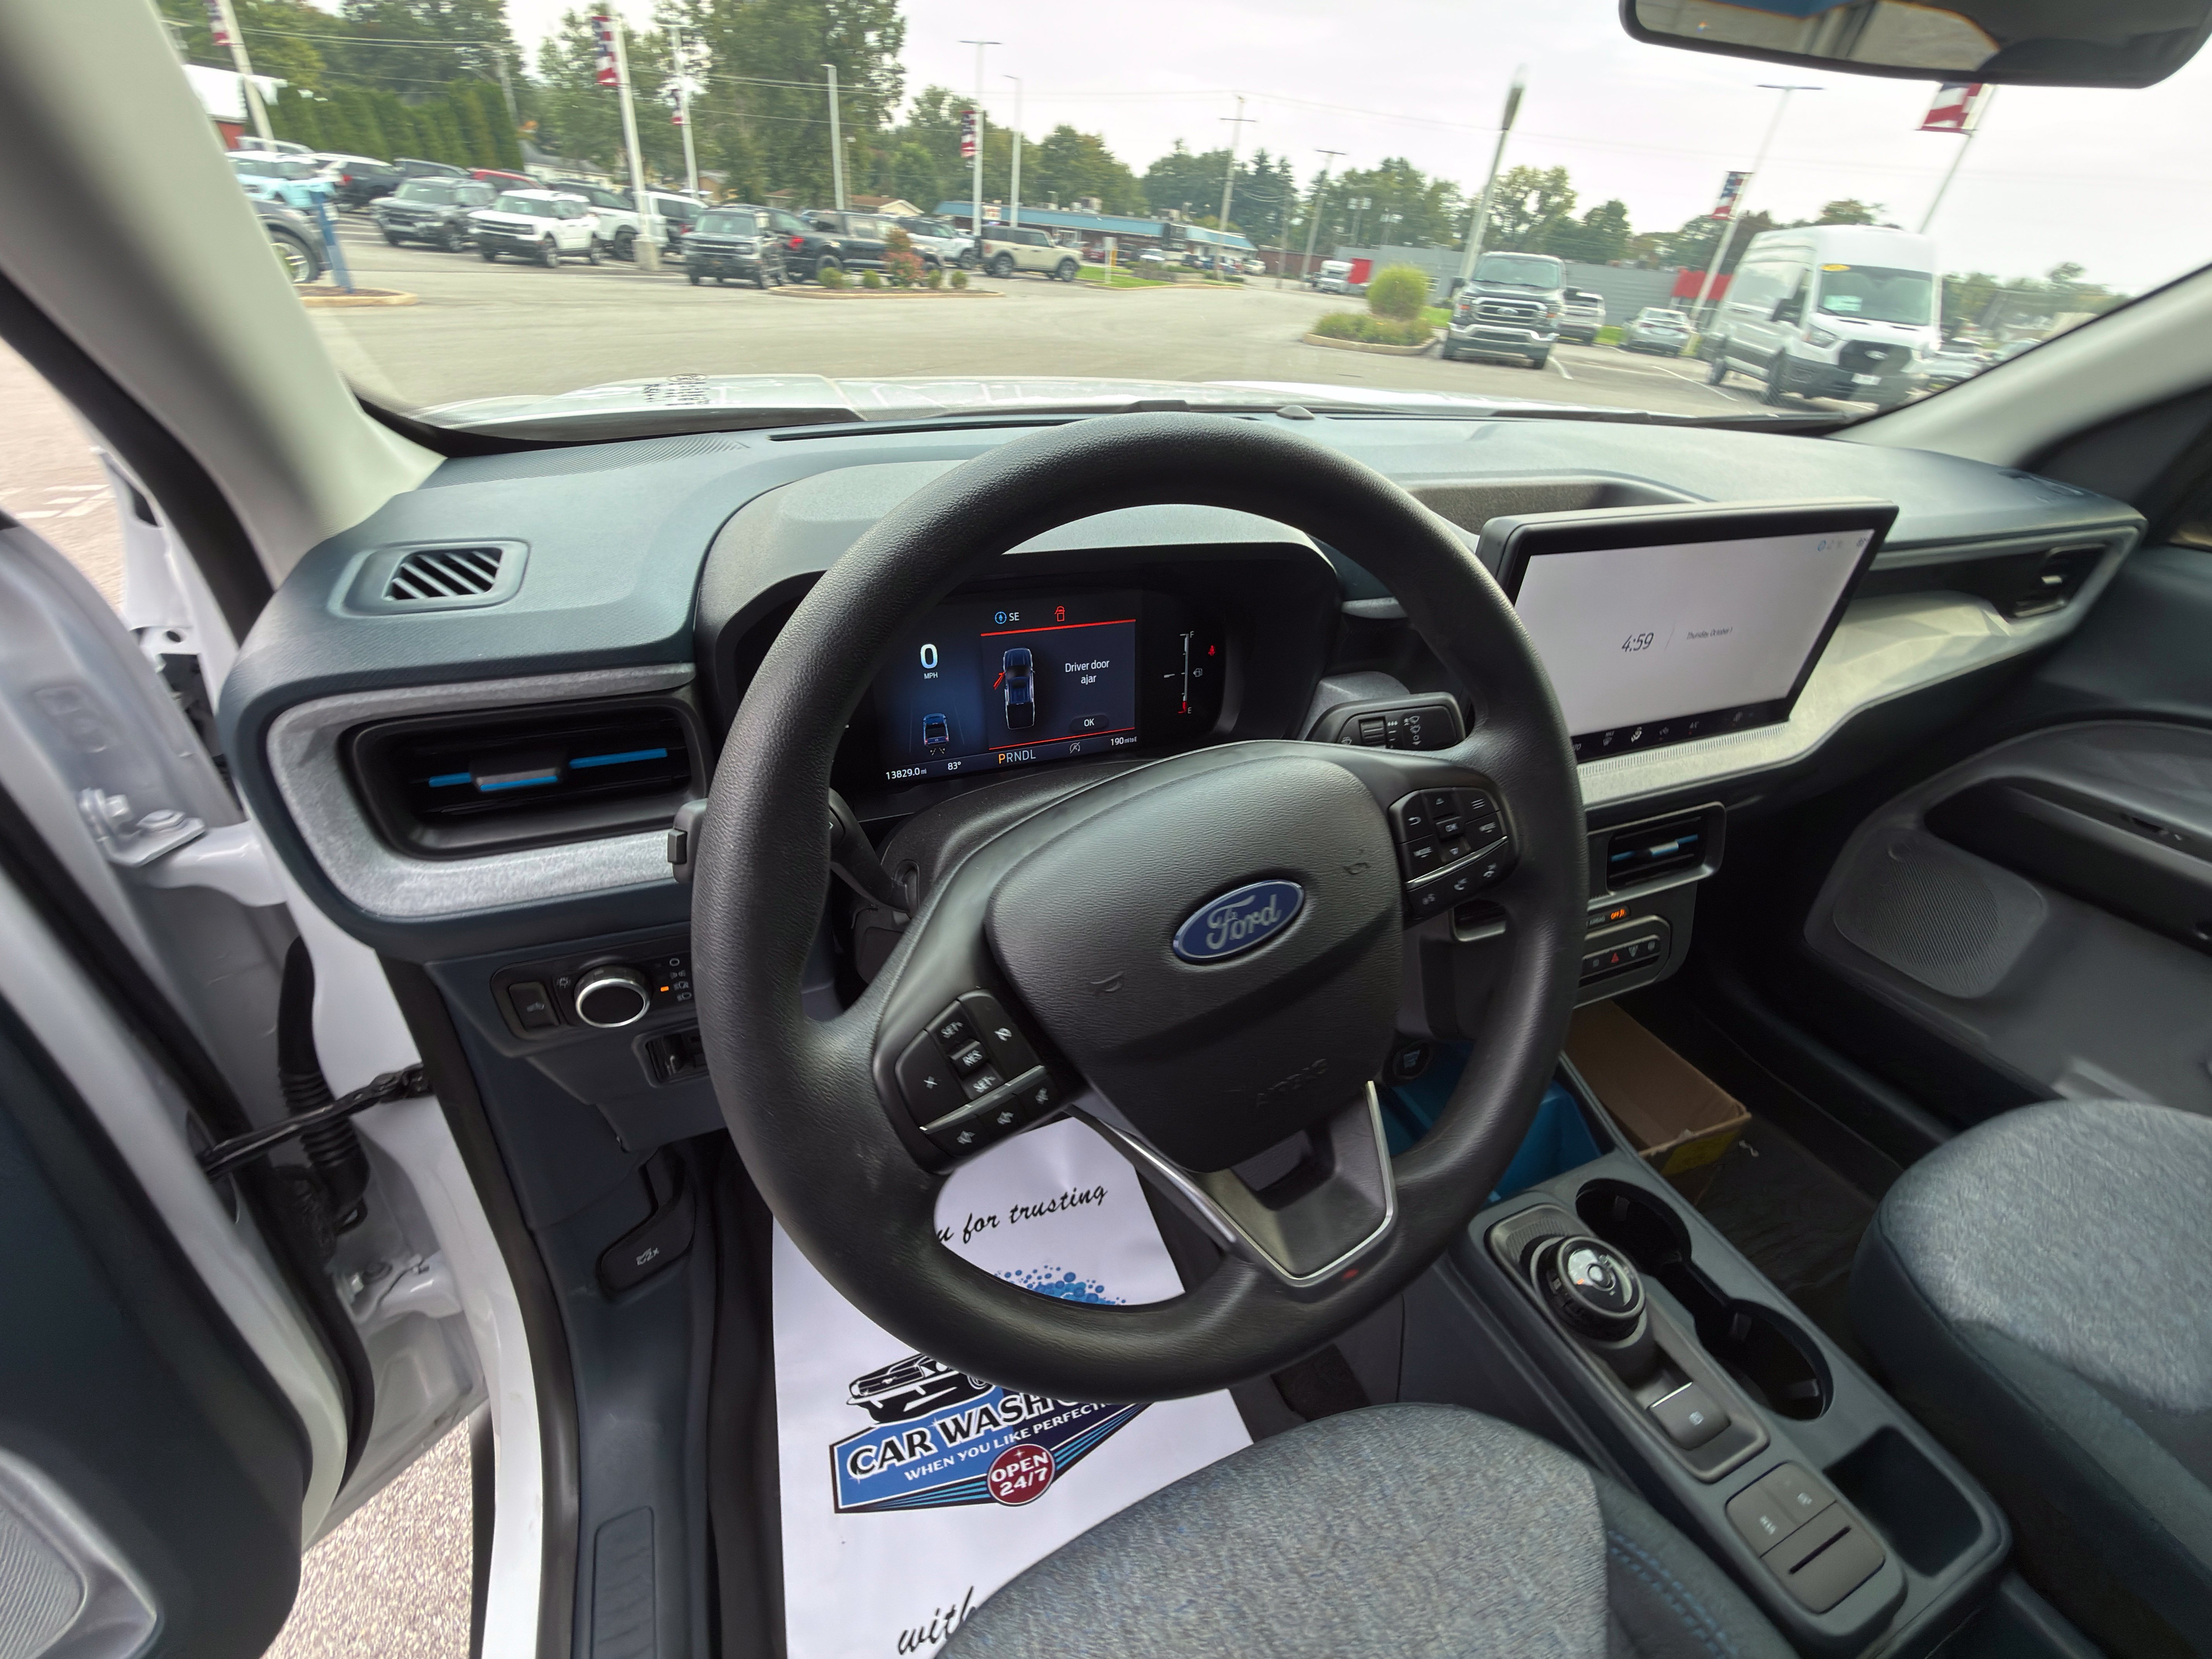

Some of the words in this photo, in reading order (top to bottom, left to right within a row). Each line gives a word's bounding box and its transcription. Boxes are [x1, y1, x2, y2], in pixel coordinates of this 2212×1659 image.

[1009, 612, 1020, 621] SE
[1621, 632, 1654, 652] 4:59
[920, 644, 938, 669] 0
[1065, 663, 1089, 673] Driver
[1091, 660, 1110, 670] door
[1081, 674, 1097, 685] ajar
[1084, 718, 1094, 726] OK
[1111, 737, 1124, 746] 190
[998, 749, 1036, 764] PRNDL
[886, 768, 920, 780] 13829.0
[948, 761, 961, 770] 83°
[1206, 894, 1282, 950] Ford
[963, 1212, 1000, 1244] for
[1008, 1185, 1108, 1224] trusting
[847, 1427, 938, 1479] CAR
[937, 1393, 1054, 1448] WASH
[904, 1455, 955, 1480] WHEN
[957, 1442, 991, 1462] YOU
[993, 1427, 1032, 1449] LIKE
[1033, 1403, 1106, 1434] PERFECT
[991, 1451, 1049, 1483] OPEN
[1000, 1467, 1048, 1496] 24/7
